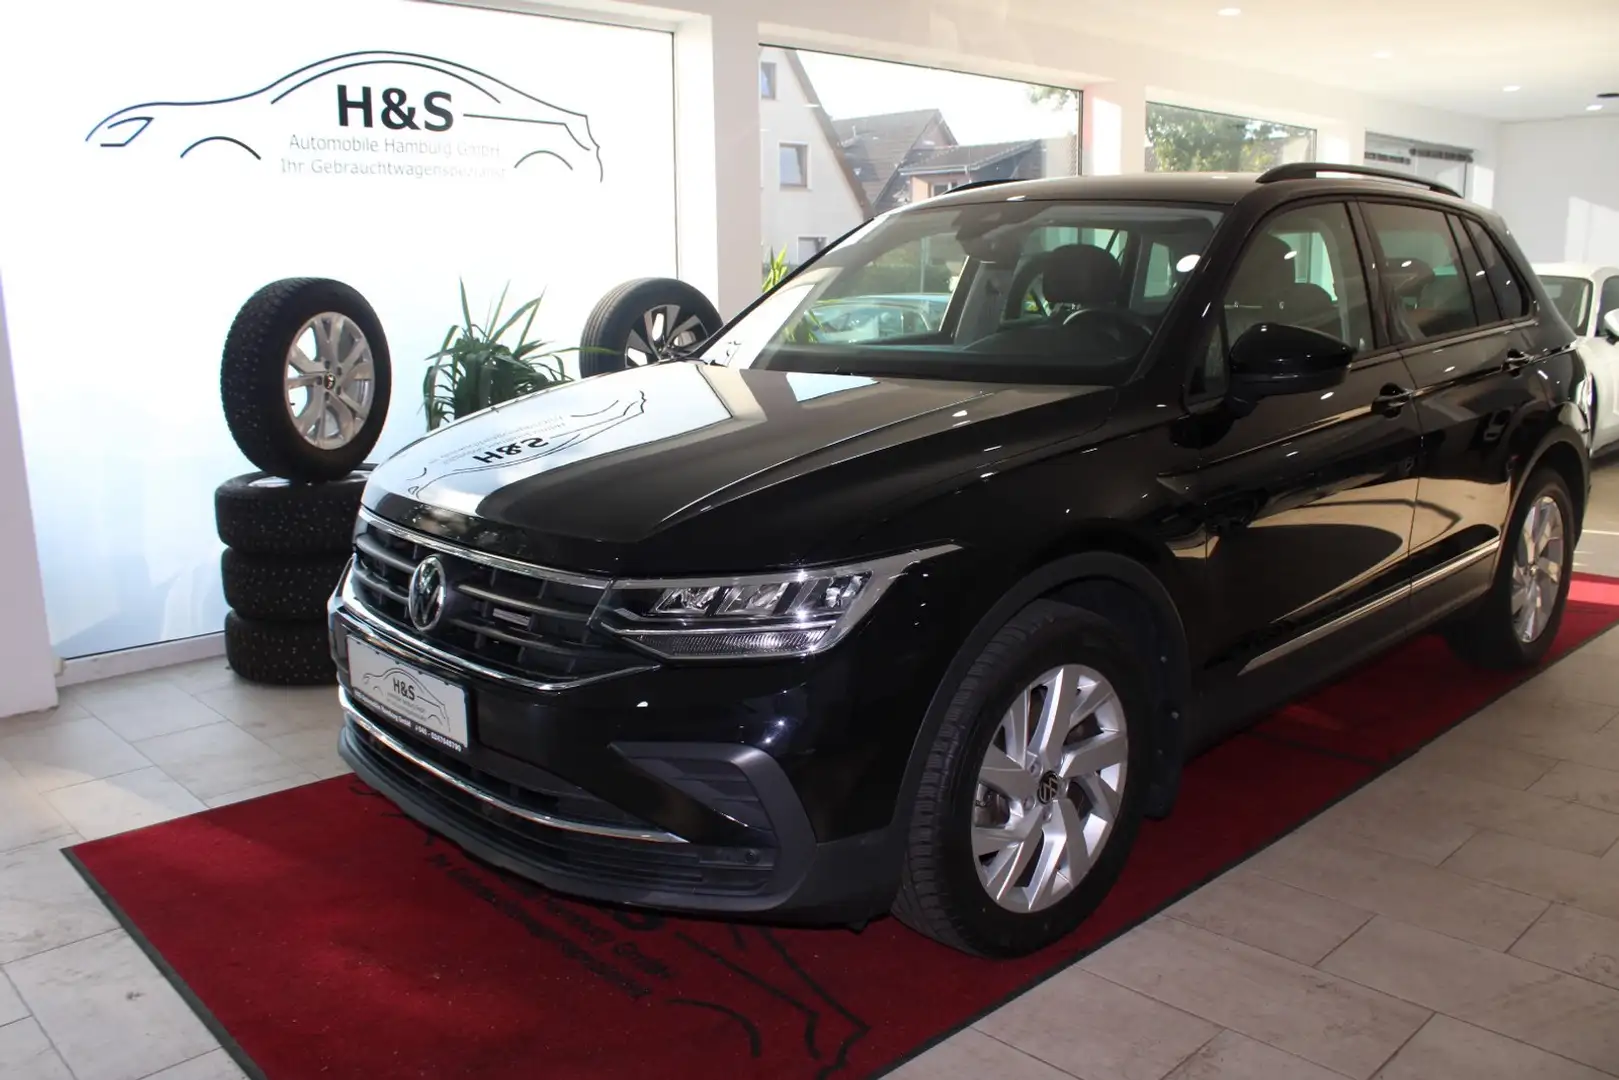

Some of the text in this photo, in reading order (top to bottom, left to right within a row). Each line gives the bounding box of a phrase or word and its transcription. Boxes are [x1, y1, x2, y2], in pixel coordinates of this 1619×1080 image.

[337, 84, 454, 132] H&S
[289, 134, 379, 153] Automobile
[383, 137, 452, 159] Hamburg
[281, 158, 305, 173] Ihr
[393, 677, 415, 701] H&S
